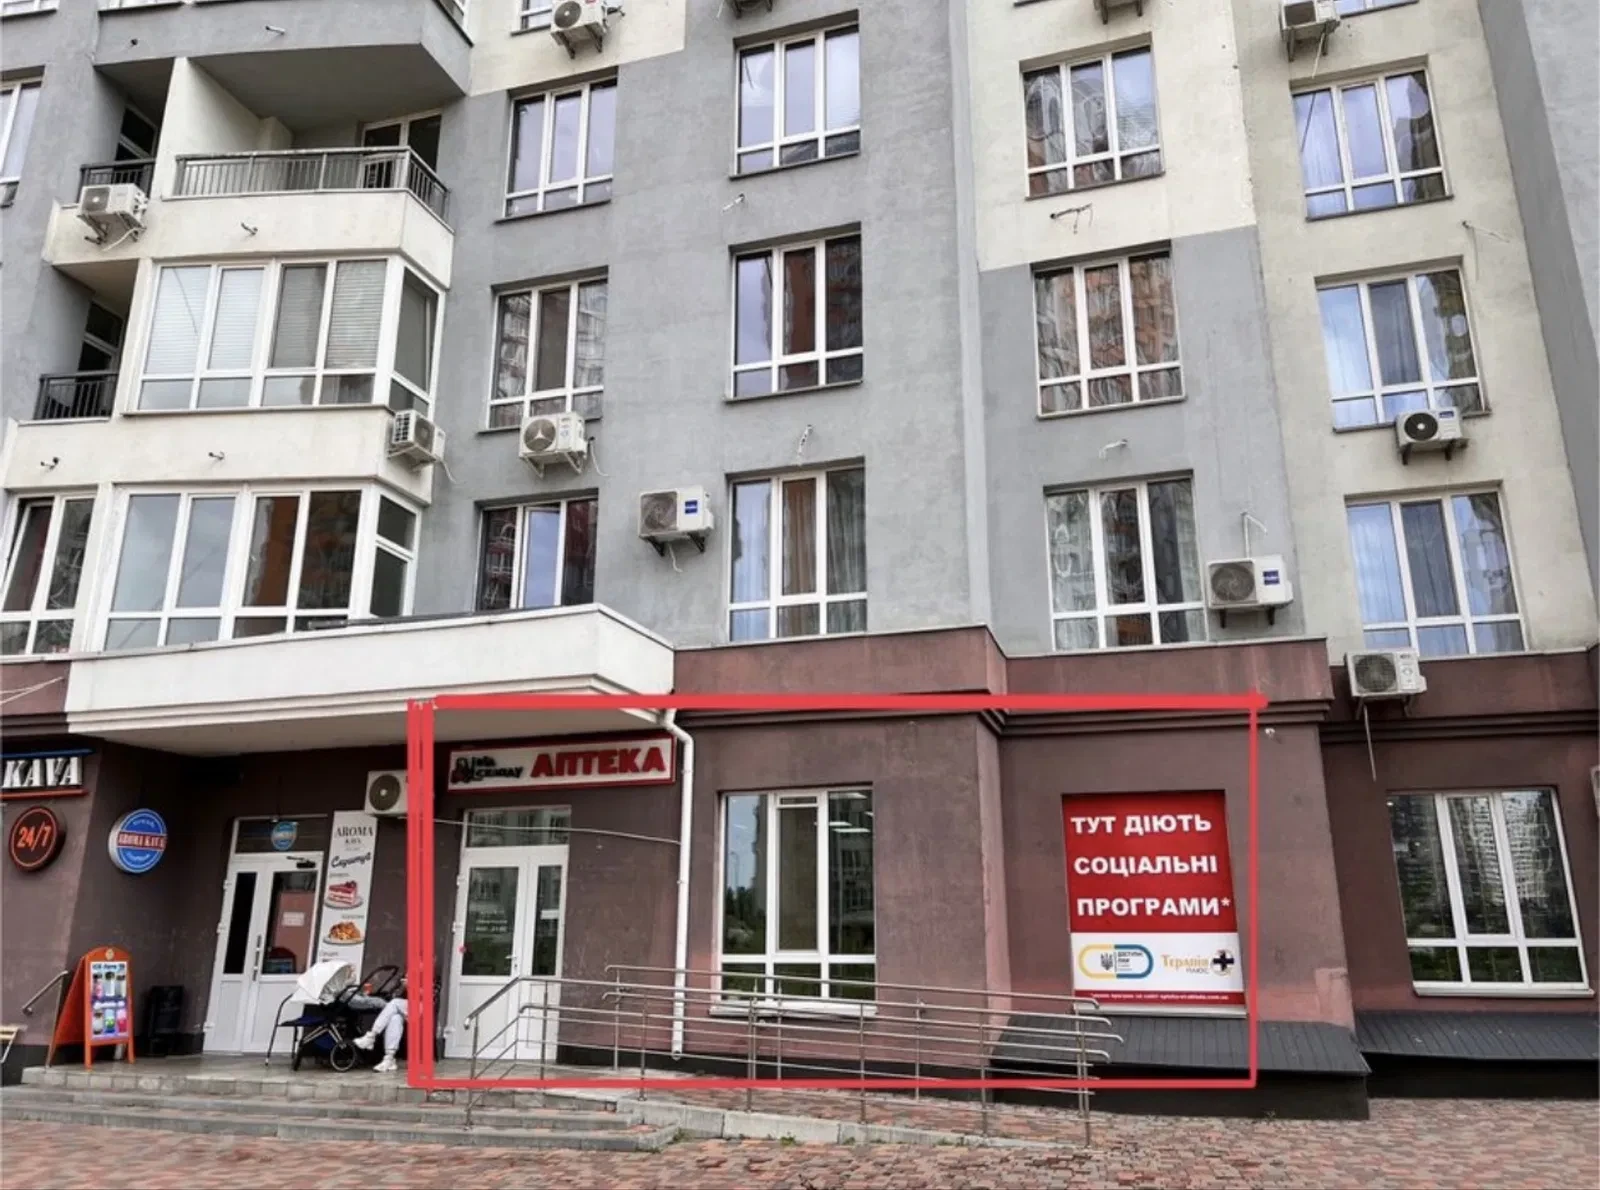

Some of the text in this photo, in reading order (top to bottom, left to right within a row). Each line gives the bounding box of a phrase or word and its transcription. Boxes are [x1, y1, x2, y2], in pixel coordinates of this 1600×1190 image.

[1, 756, 83, 789] KAVA
[531, 747, 666, 778] АПТЕКА
[16, 821, 52, 852] 24/7
[336, 826, 373, 837] AROMA
[1070, 813, 1212, 836] ТУТ ДІЮТЬ
[1073, 855, 1218, 877] СОЦІАЛЬНІ
